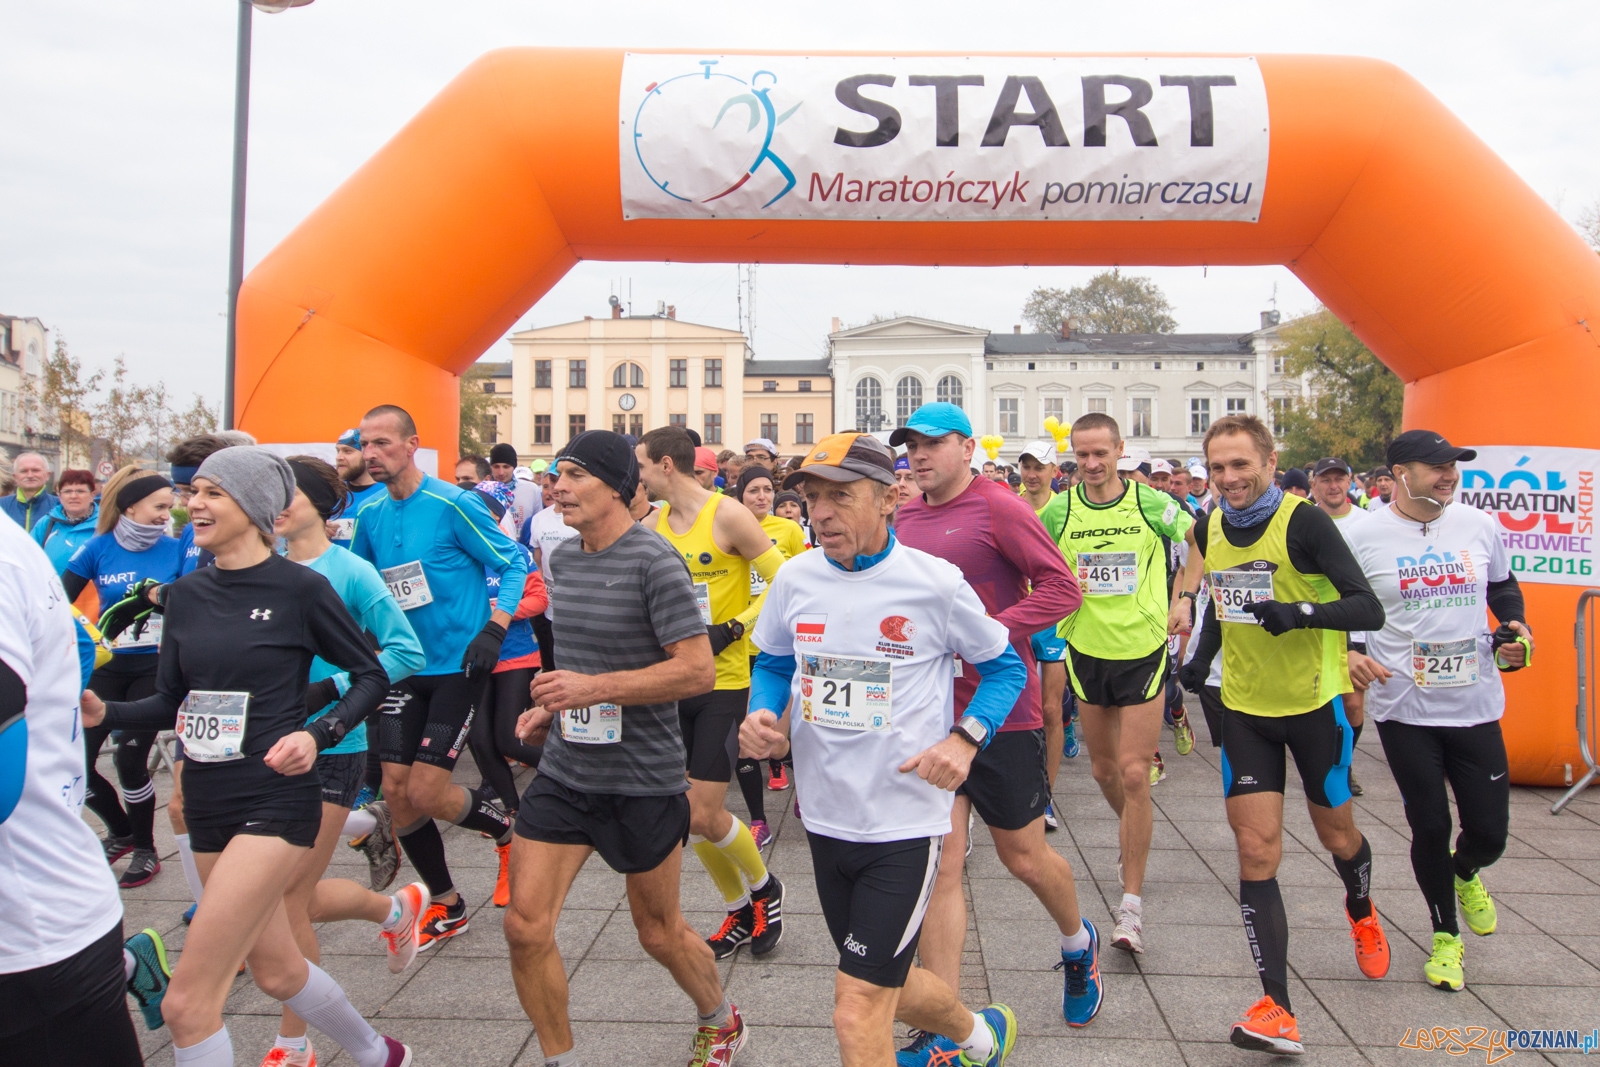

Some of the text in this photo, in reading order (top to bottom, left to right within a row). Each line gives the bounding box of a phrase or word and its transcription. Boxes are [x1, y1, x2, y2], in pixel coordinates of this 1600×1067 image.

[833, 73, 1237, 148] START
[808, 170, 1030, 210] Maratończyk
[1461, 491, 1576, 513] MARATON
[1578, 470, 1594, 535] SKOKI
[1070, 526, 1141, 539] BROOKS
[1501, 532, 1592, 553] GROWIEC
[691, 569, 729, 577] ONSTRUKTOR
[1399, 563, 1466, 579] MARATON
[1460, 549, 1477, 582] SKOKI
[1511, 555, 1592, 575] 0.2016
[99, 572, 136, 585] HART
[1089, 566, 1119, 582] 461
[1222, 588, 1255, 607] 364
[1400, 583, 1477, 600] WĄGROWIEC
[1404, 595, 1477, 611] 23.10.2016
[796, 635, 823, 643] POLSKA
[1427, 656, 1464, 673] 247
[822, 680, 851, 707] 21
[570, 707, 591, 724] 40
[817, 716, 843, 726] POLINOVA
[824, 708, 850, 718] Henryk
[185, 715, 220, 740] 508
